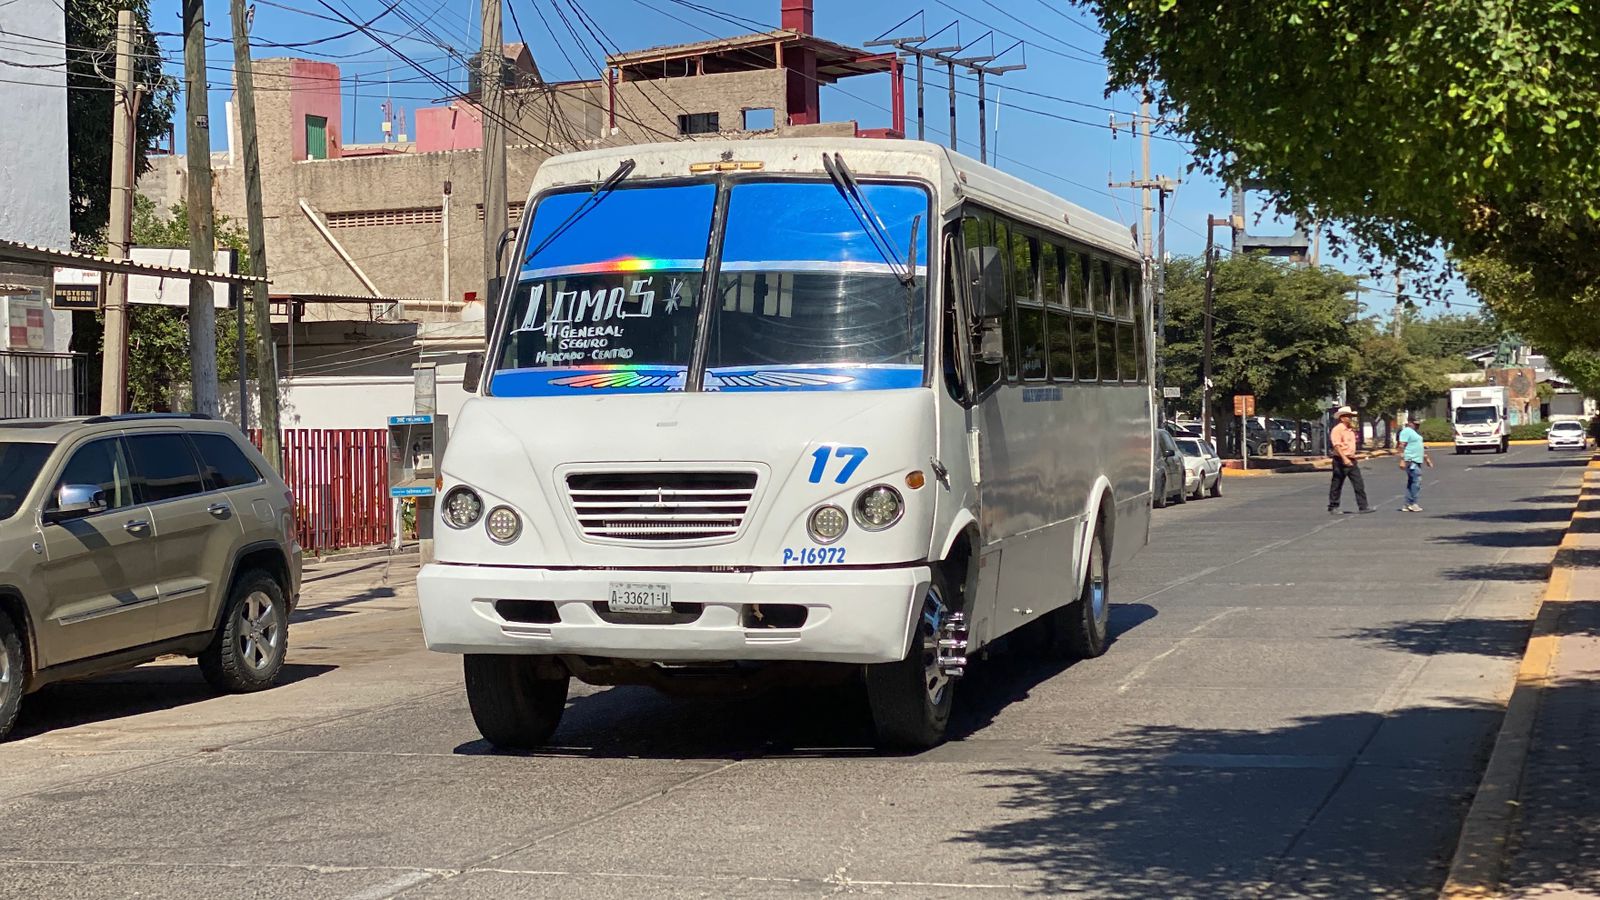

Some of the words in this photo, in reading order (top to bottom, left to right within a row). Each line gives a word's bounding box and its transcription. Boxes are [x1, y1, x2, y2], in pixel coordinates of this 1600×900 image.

[510, 277, 655, 335] LOMAS
[559, 338, 609, 350] SEGURO
[808, 445, 869, 485] 17
[783, 547, 847, 565] P-16972
[611, 590, 669, 607] A-33621-U
